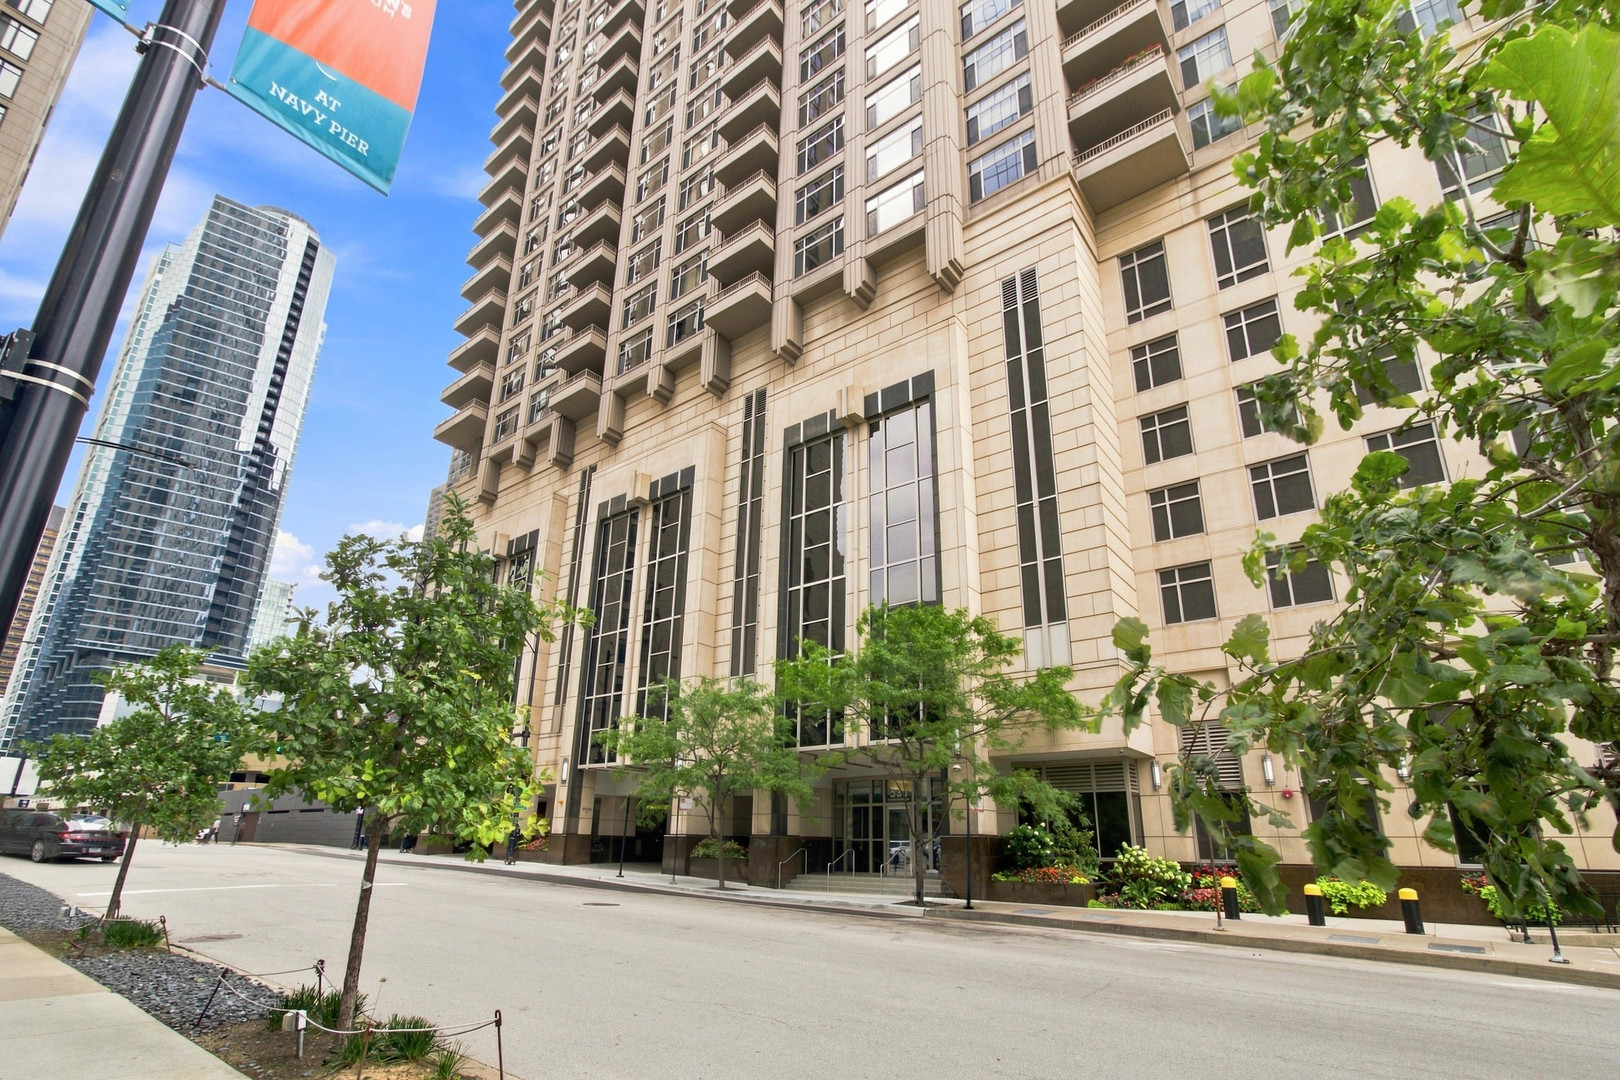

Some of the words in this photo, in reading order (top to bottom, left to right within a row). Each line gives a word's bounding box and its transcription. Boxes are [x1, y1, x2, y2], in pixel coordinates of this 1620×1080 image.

[269, 81, 327, 125] NAVY
[328, 120, 369, 156] PIER
[314, 89, 341, 112] AT
